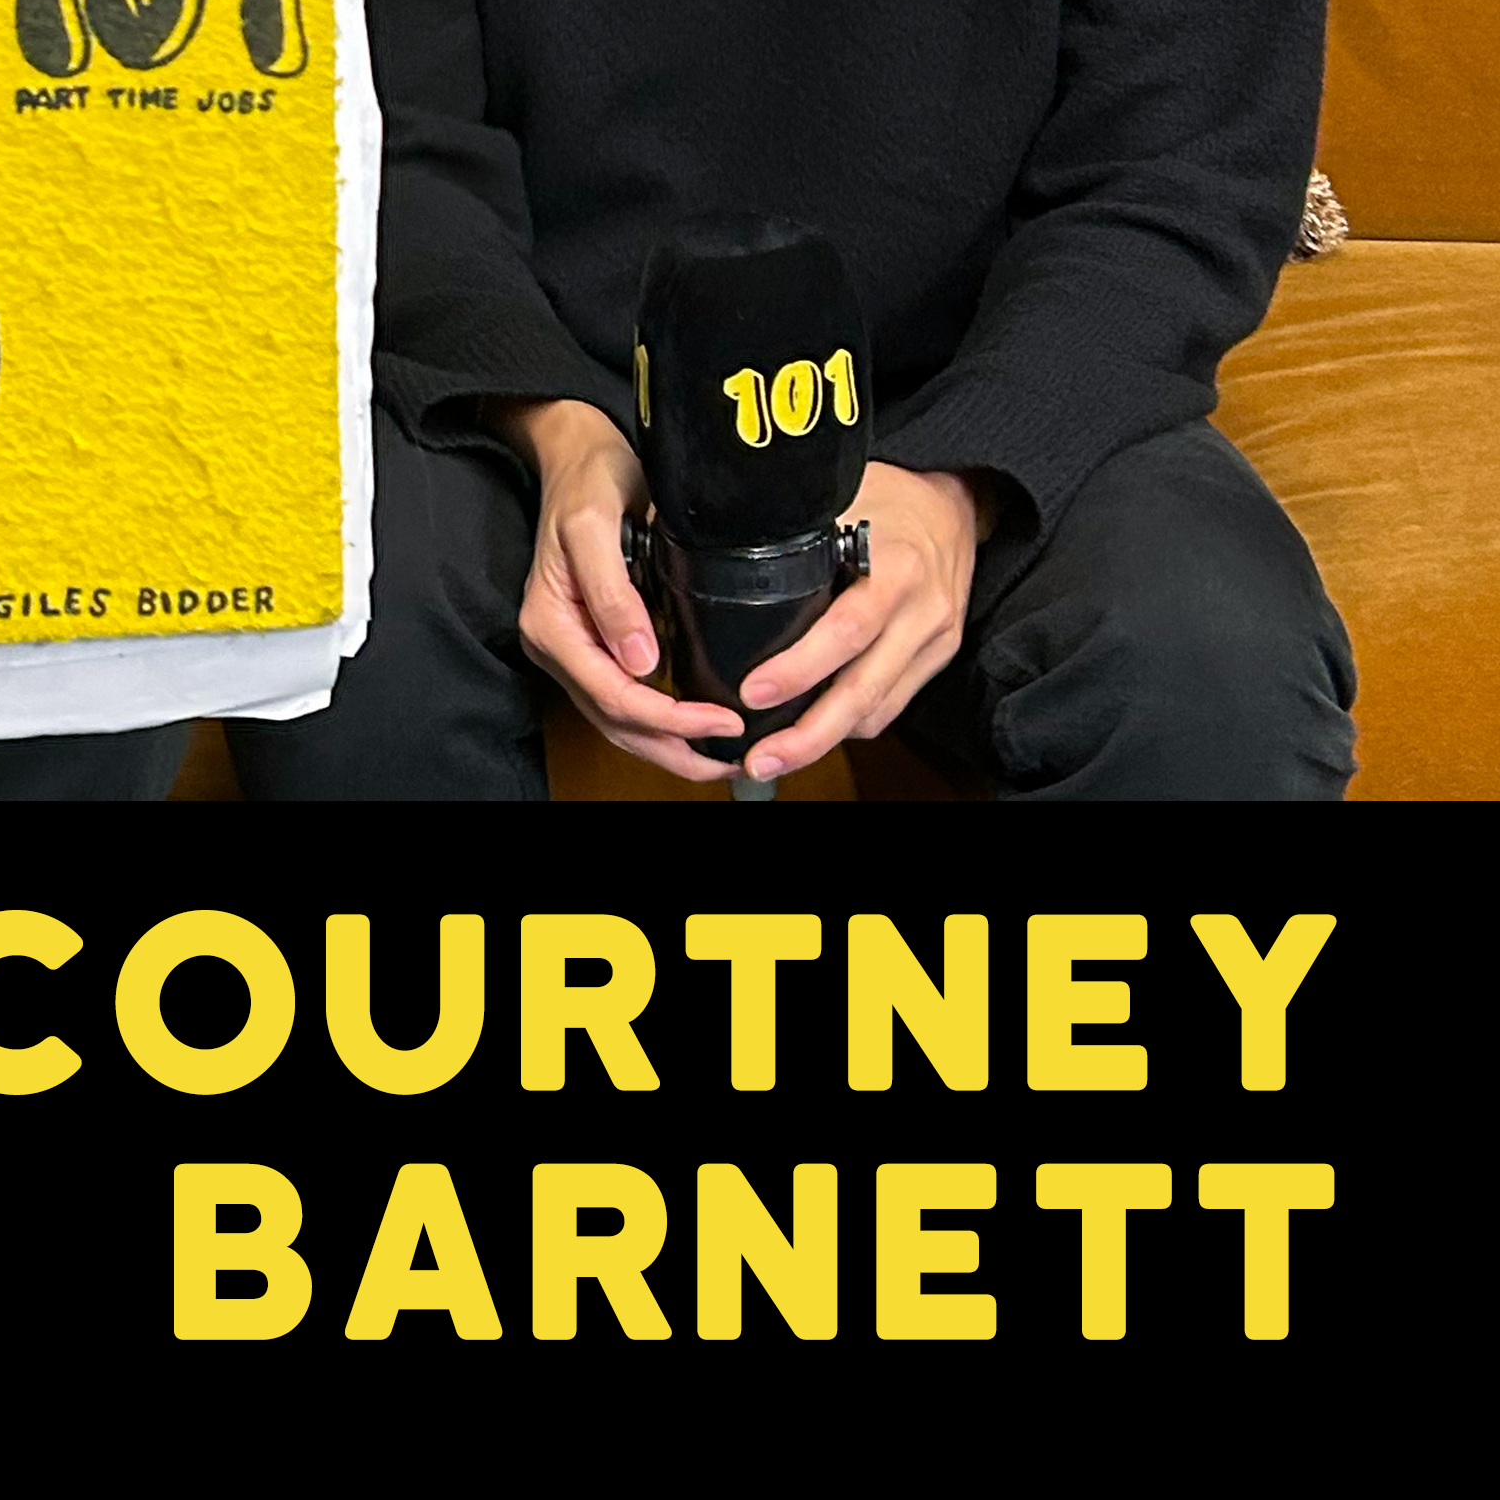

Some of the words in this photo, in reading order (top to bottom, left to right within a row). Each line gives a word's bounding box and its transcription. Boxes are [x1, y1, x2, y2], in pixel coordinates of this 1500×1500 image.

[15, 85, 91, 114] PART
[107, 87, 179, 111] TIME
[197, 88, 277, 115] JOBS
[722, 348, 860, 448] 101
[137, 585, 275, 617] BIDDER
